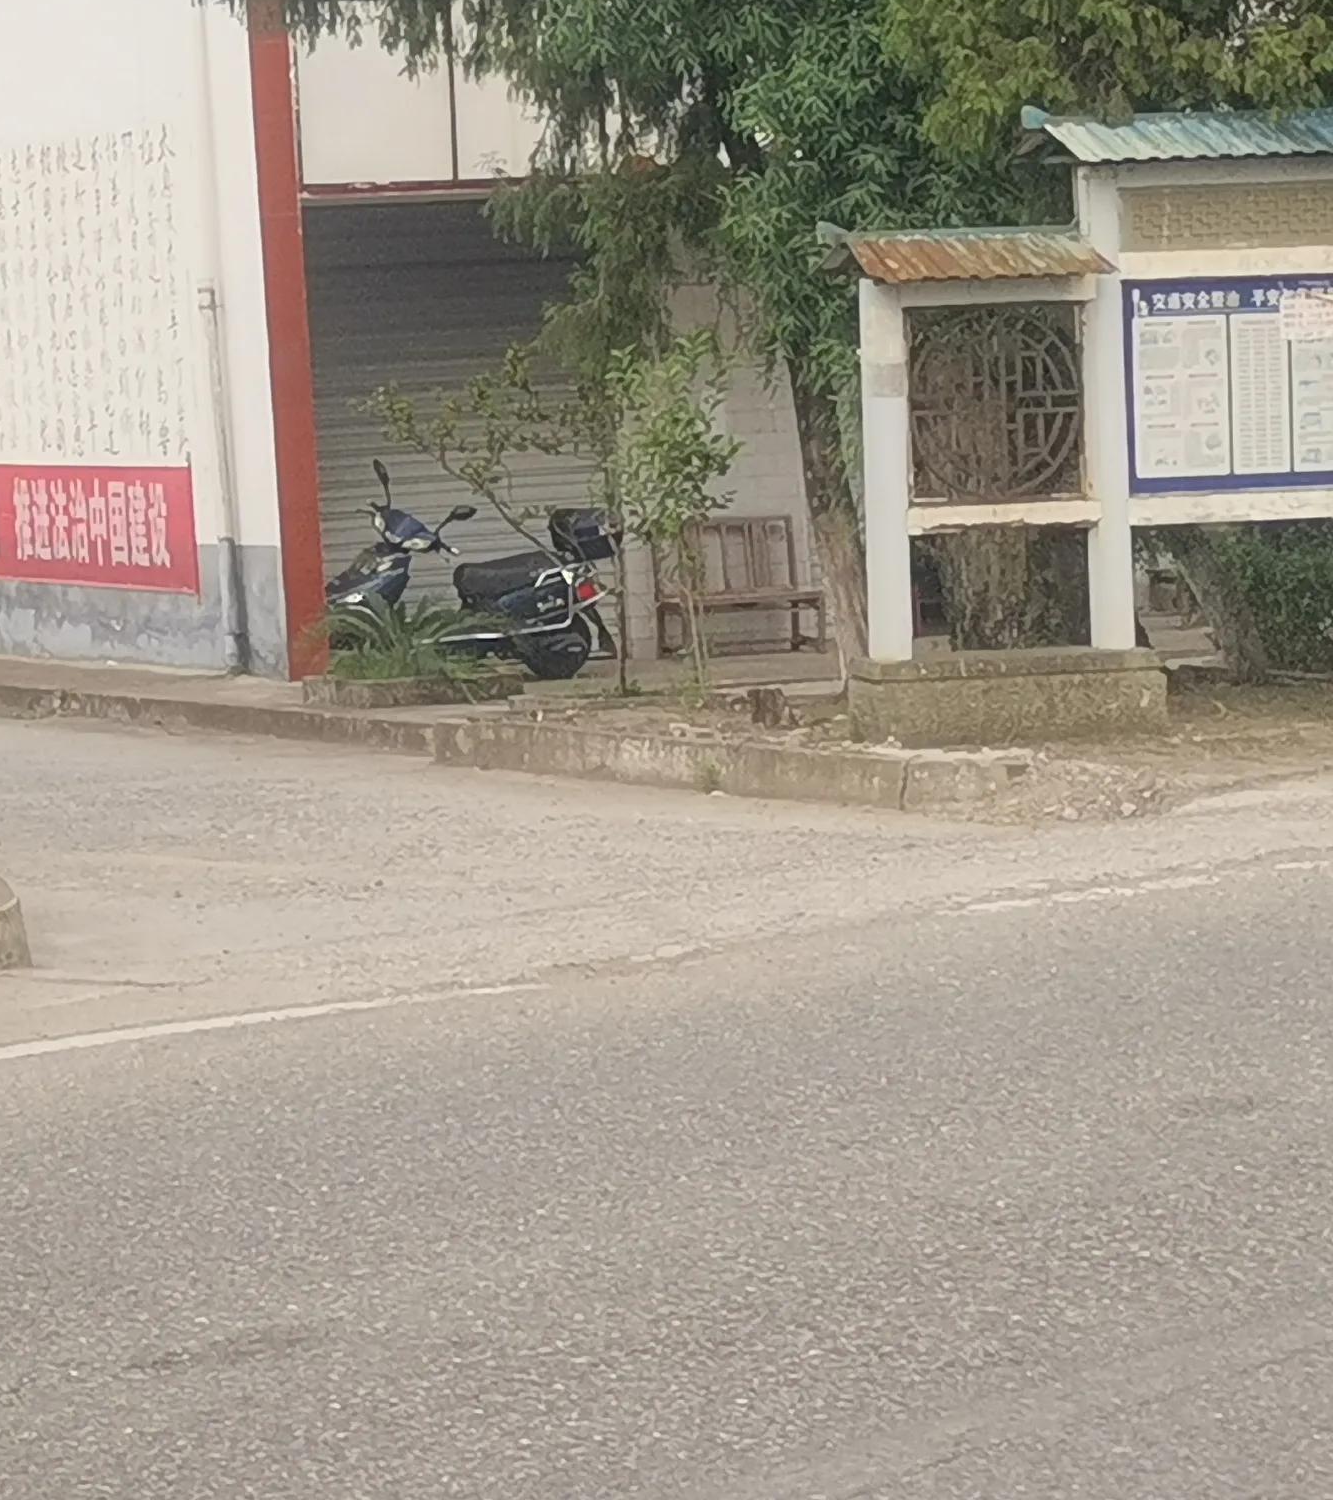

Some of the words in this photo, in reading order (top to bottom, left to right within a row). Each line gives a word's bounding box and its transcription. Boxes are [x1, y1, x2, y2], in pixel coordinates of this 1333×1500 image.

[14, 477, 171, 569] 推进法治中国建设
